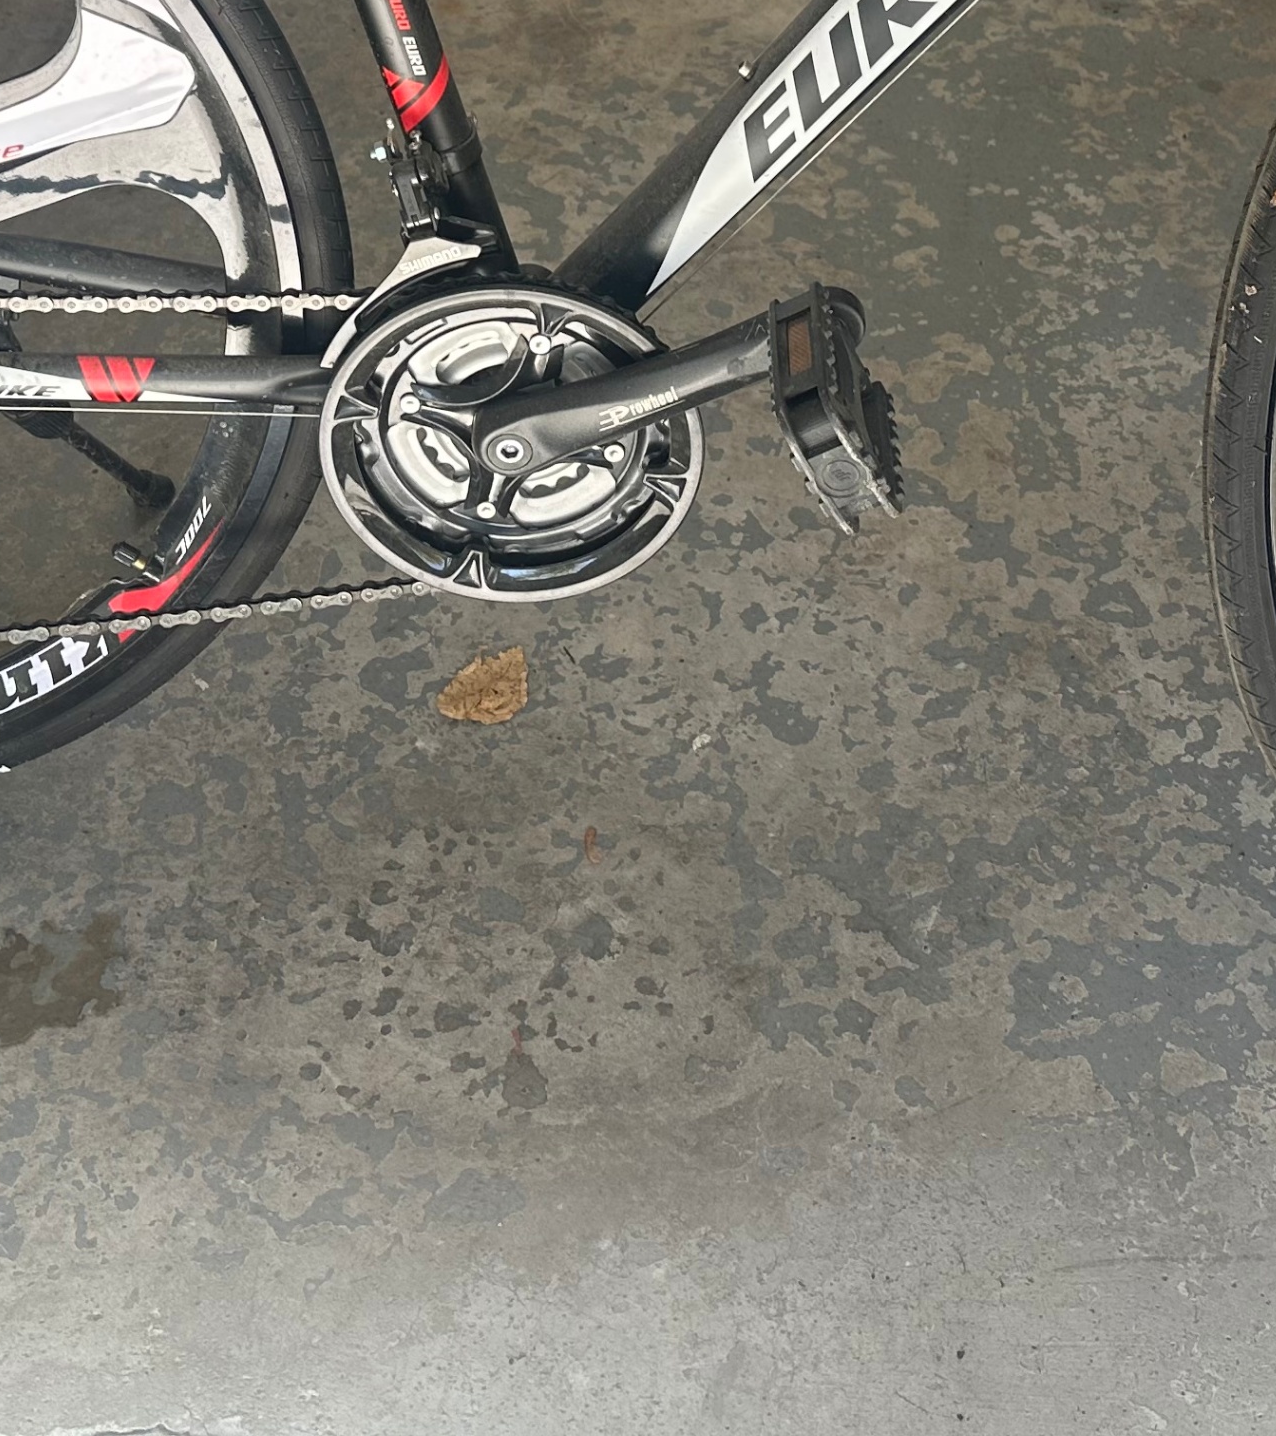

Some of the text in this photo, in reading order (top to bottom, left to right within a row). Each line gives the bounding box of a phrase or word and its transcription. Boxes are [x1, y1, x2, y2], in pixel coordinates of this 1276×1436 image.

[402, 36, 427, 77] EURO
[399, 246, 462, 275] SHIMANO
[599, 385, 679, 427] Prowheel
[173, 495, 212, 564] 700C
